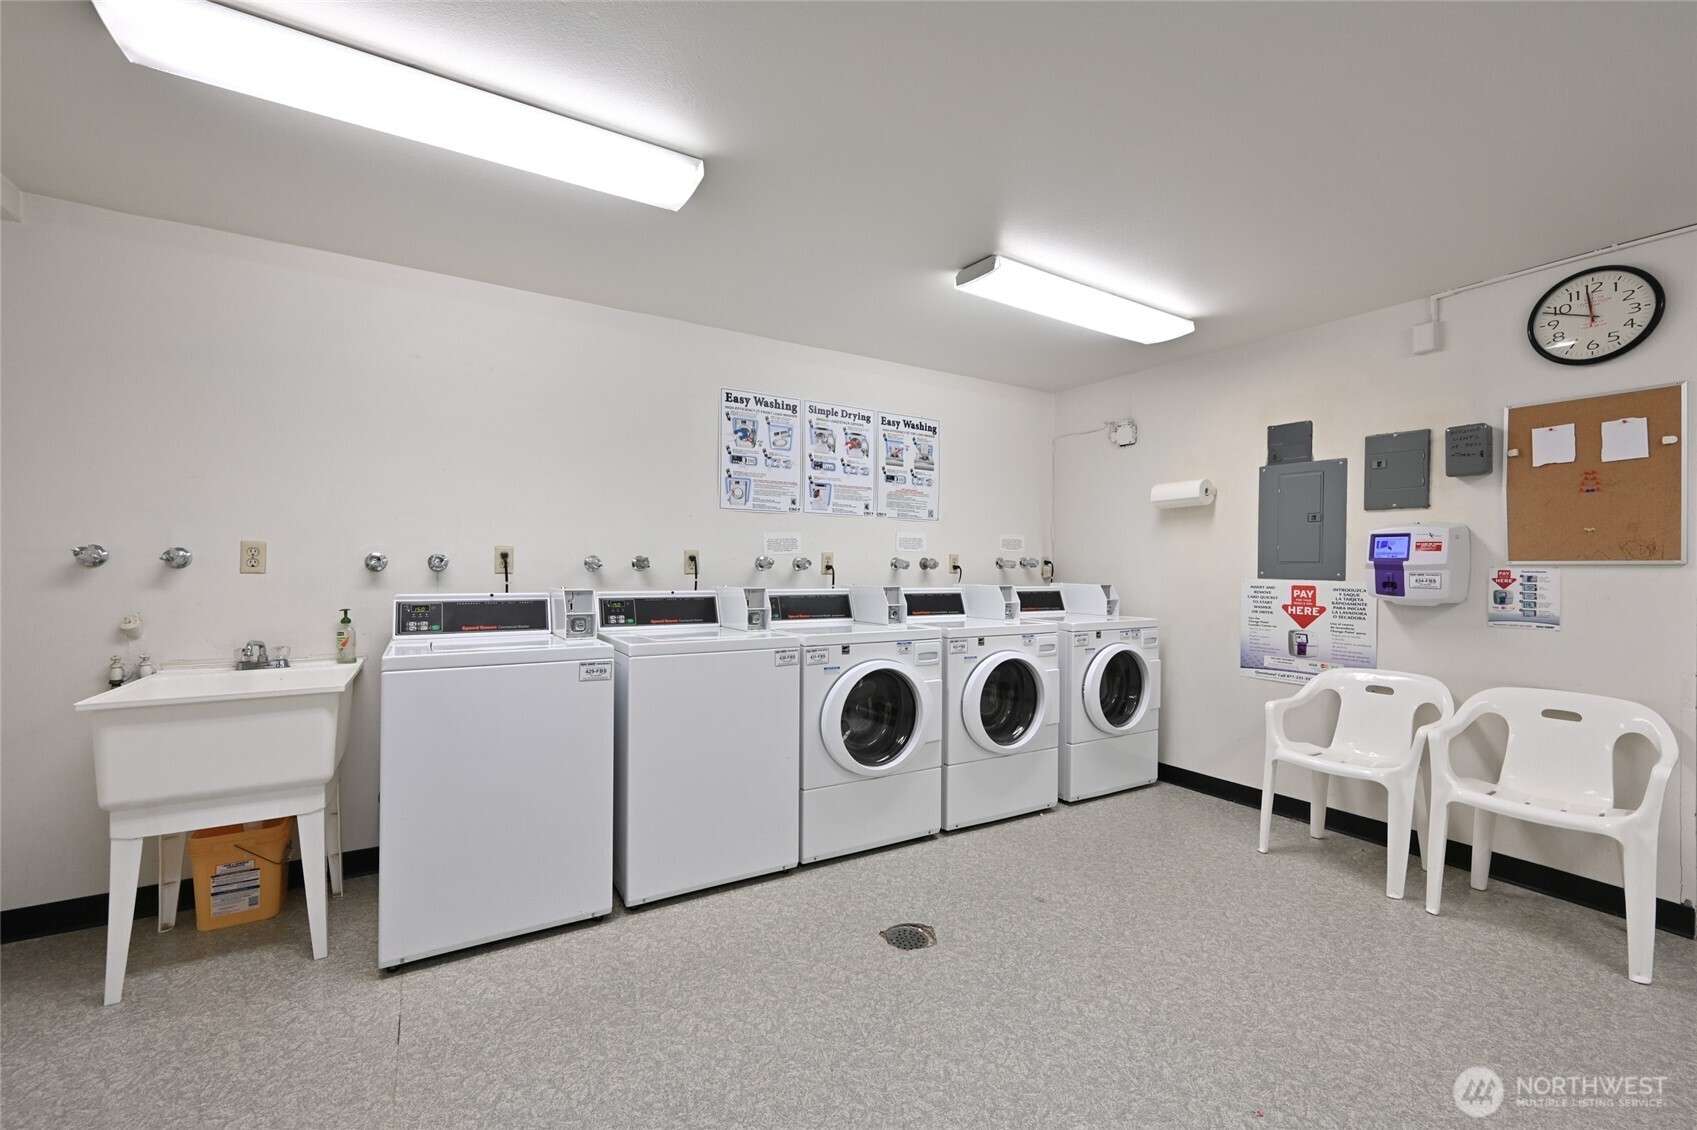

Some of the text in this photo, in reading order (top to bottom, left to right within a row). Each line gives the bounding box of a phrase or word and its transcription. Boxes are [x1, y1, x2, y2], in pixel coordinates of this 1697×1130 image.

[1614, 282, 1618, 292] 1
[1569, 291, 1580, 302] 11
[1622, 290, 1635, 301] 2
[1553, 304, 1571, 315] 10
[1628, 303, 1641, 314] 3
[1548, 320, 1560, 330] 9
[1623, 318, 1636, 328] 4
[1553, 332, 1565, 342] 8
[1608, 331, 1620, 342] 5
[1587, 340, 1599, 350] 6
[725, 392, 798, 414] Easy Washing
[808, 405, 871, 424] Simple Drying
[881, 416, 937, 435] Easy Washing
[1294, 590, 1314, 598] PAY
[1288, 606, 1319, 616] HERE
